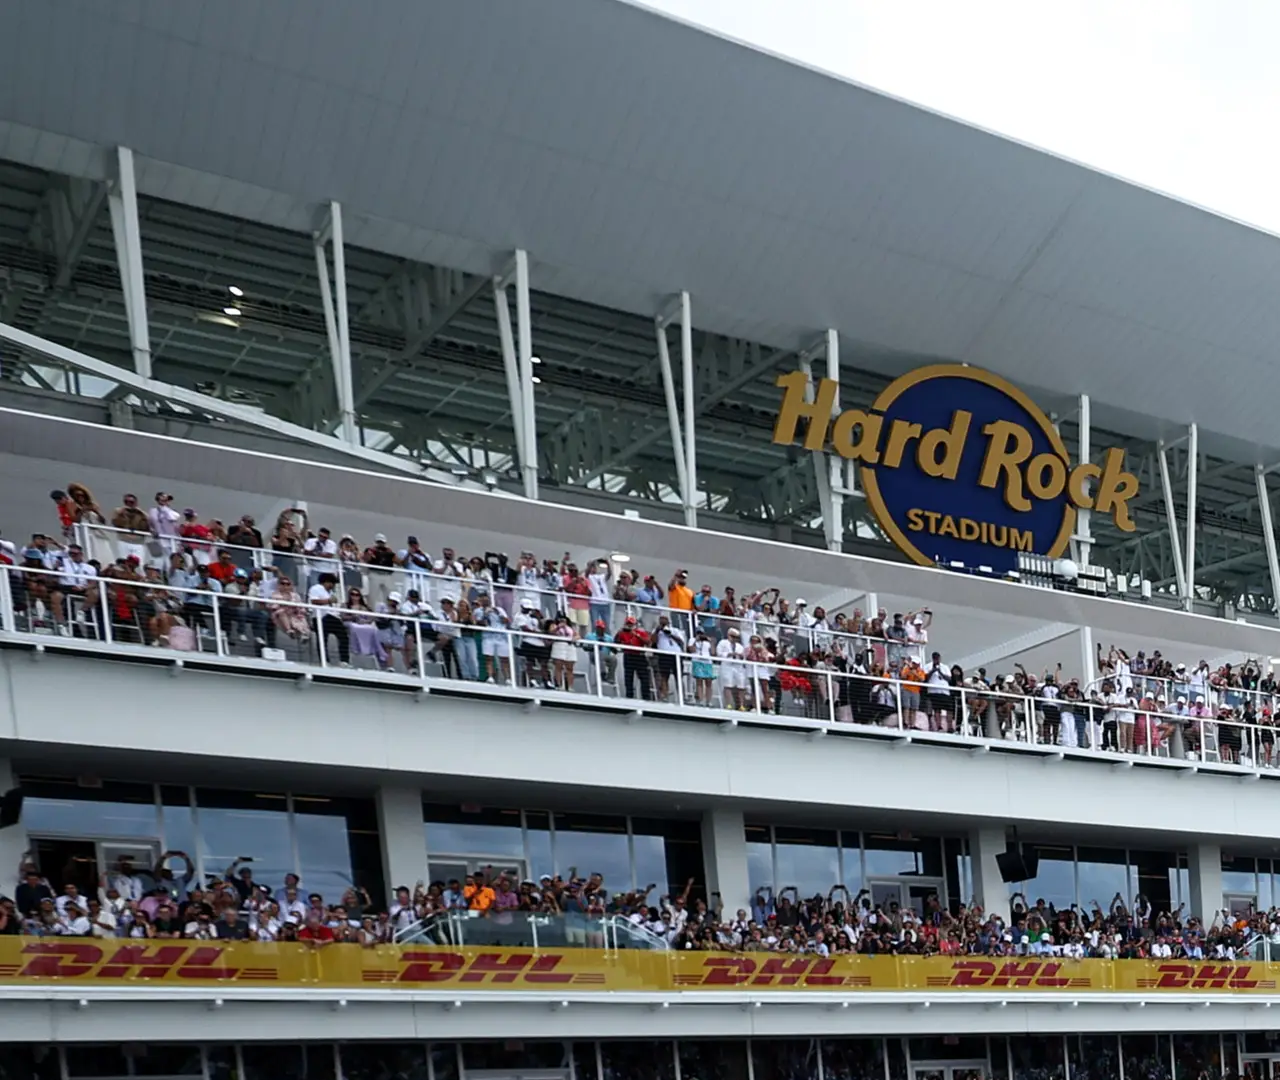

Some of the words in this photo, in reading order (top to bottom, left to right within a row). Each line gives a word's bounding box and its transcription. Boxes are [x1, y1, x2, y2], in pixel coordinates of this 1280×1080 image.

[772, 369, 973, 481] Hard
[978, 419, 1140, 533] Rock
[906, 507, 1034, 553] STADIUM
[20, 943, 239, 980] DHL
[399, 951, 575, 984] DHL
[703, 958, 849, 986] DHL
[949, 961, 1070, 988] DHL
[1157, 965, 1258, 989] DHL
